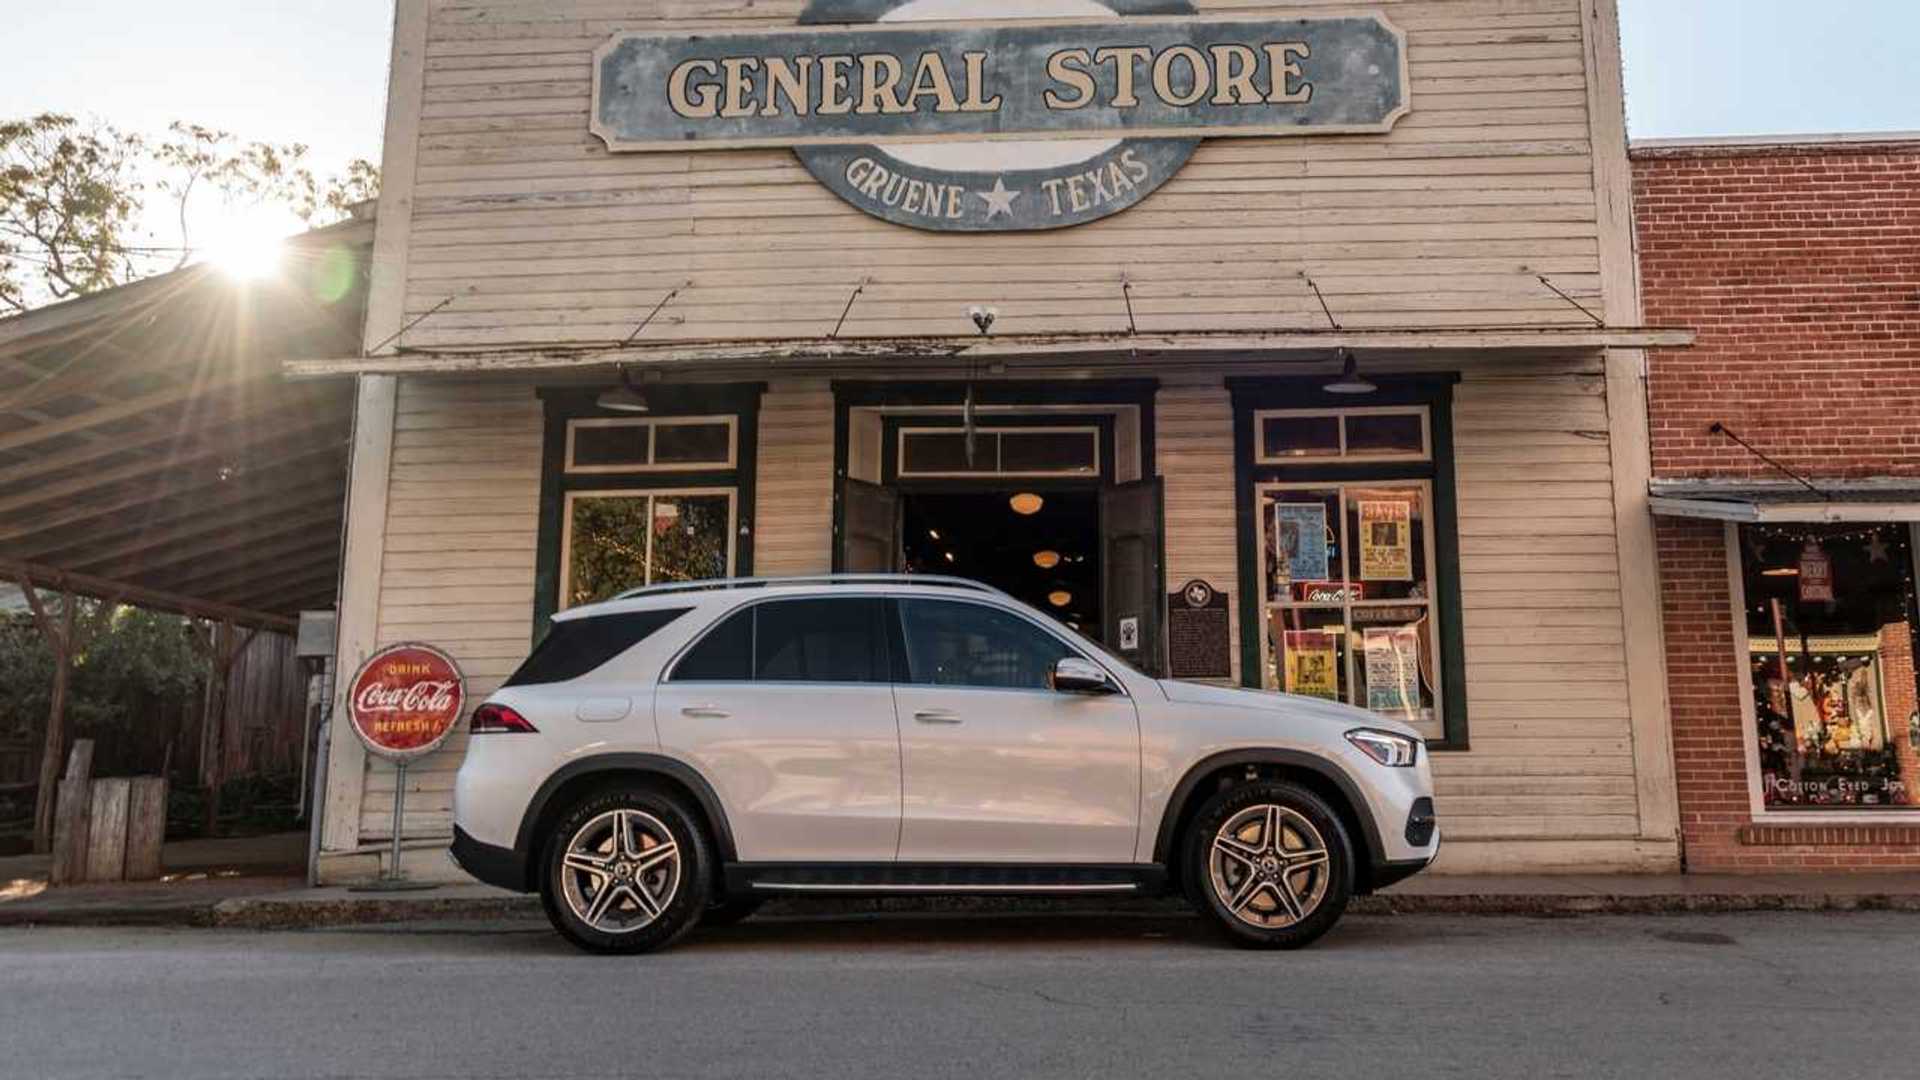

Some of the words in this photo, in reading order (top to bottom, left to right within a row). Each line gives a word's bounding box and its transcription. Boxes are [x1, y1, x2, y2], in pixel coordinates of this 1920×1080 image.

[667, 50, 1003, 119] GENERAL
[1043, 41, 1313, 110] STORE
[846, 157, 964, 219] GRUENE
[1042, 151, 1148, 216] TEXAS
[390, 663, 431, 675] DRINK
[358, 681, 455, 712] Coca-Cola
